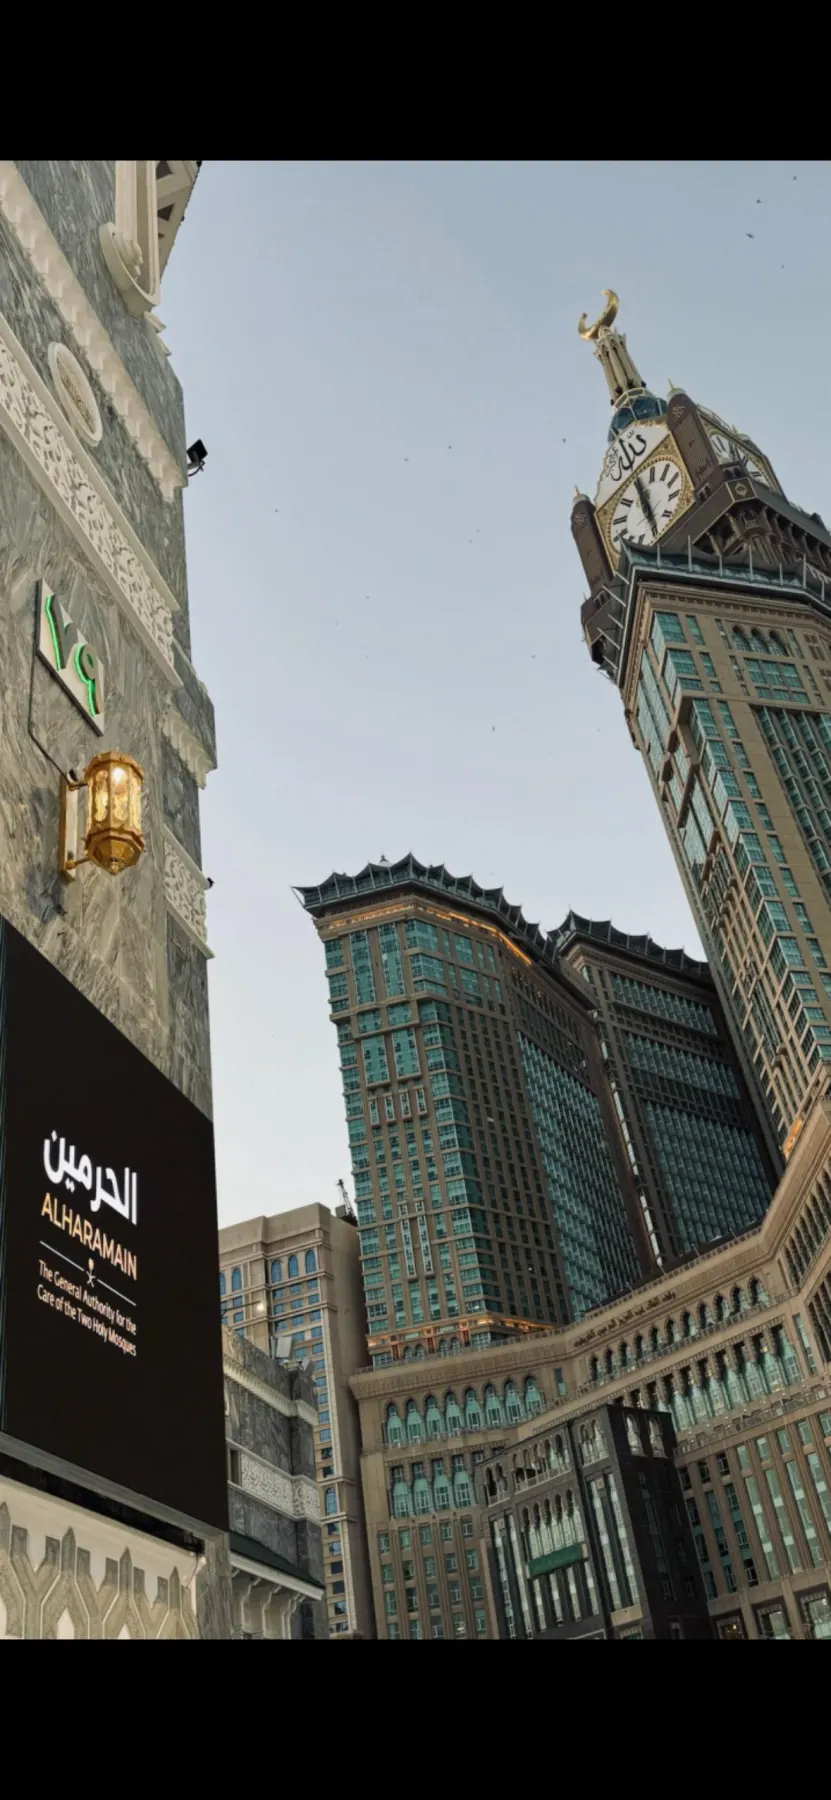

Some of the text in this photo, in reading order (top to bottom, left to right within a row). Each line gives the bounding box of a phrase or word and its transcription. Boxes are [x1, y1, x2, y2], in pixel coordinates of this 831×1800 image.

[43, 1130, 137, 1226] الحرمين
[41, 1192, 137, 1281] ALHARAMAIN
[37, 1284, 137, 1356] Care of the Two Holy Mosques
[39, 1259, 137, 1335] The General Authority for the
